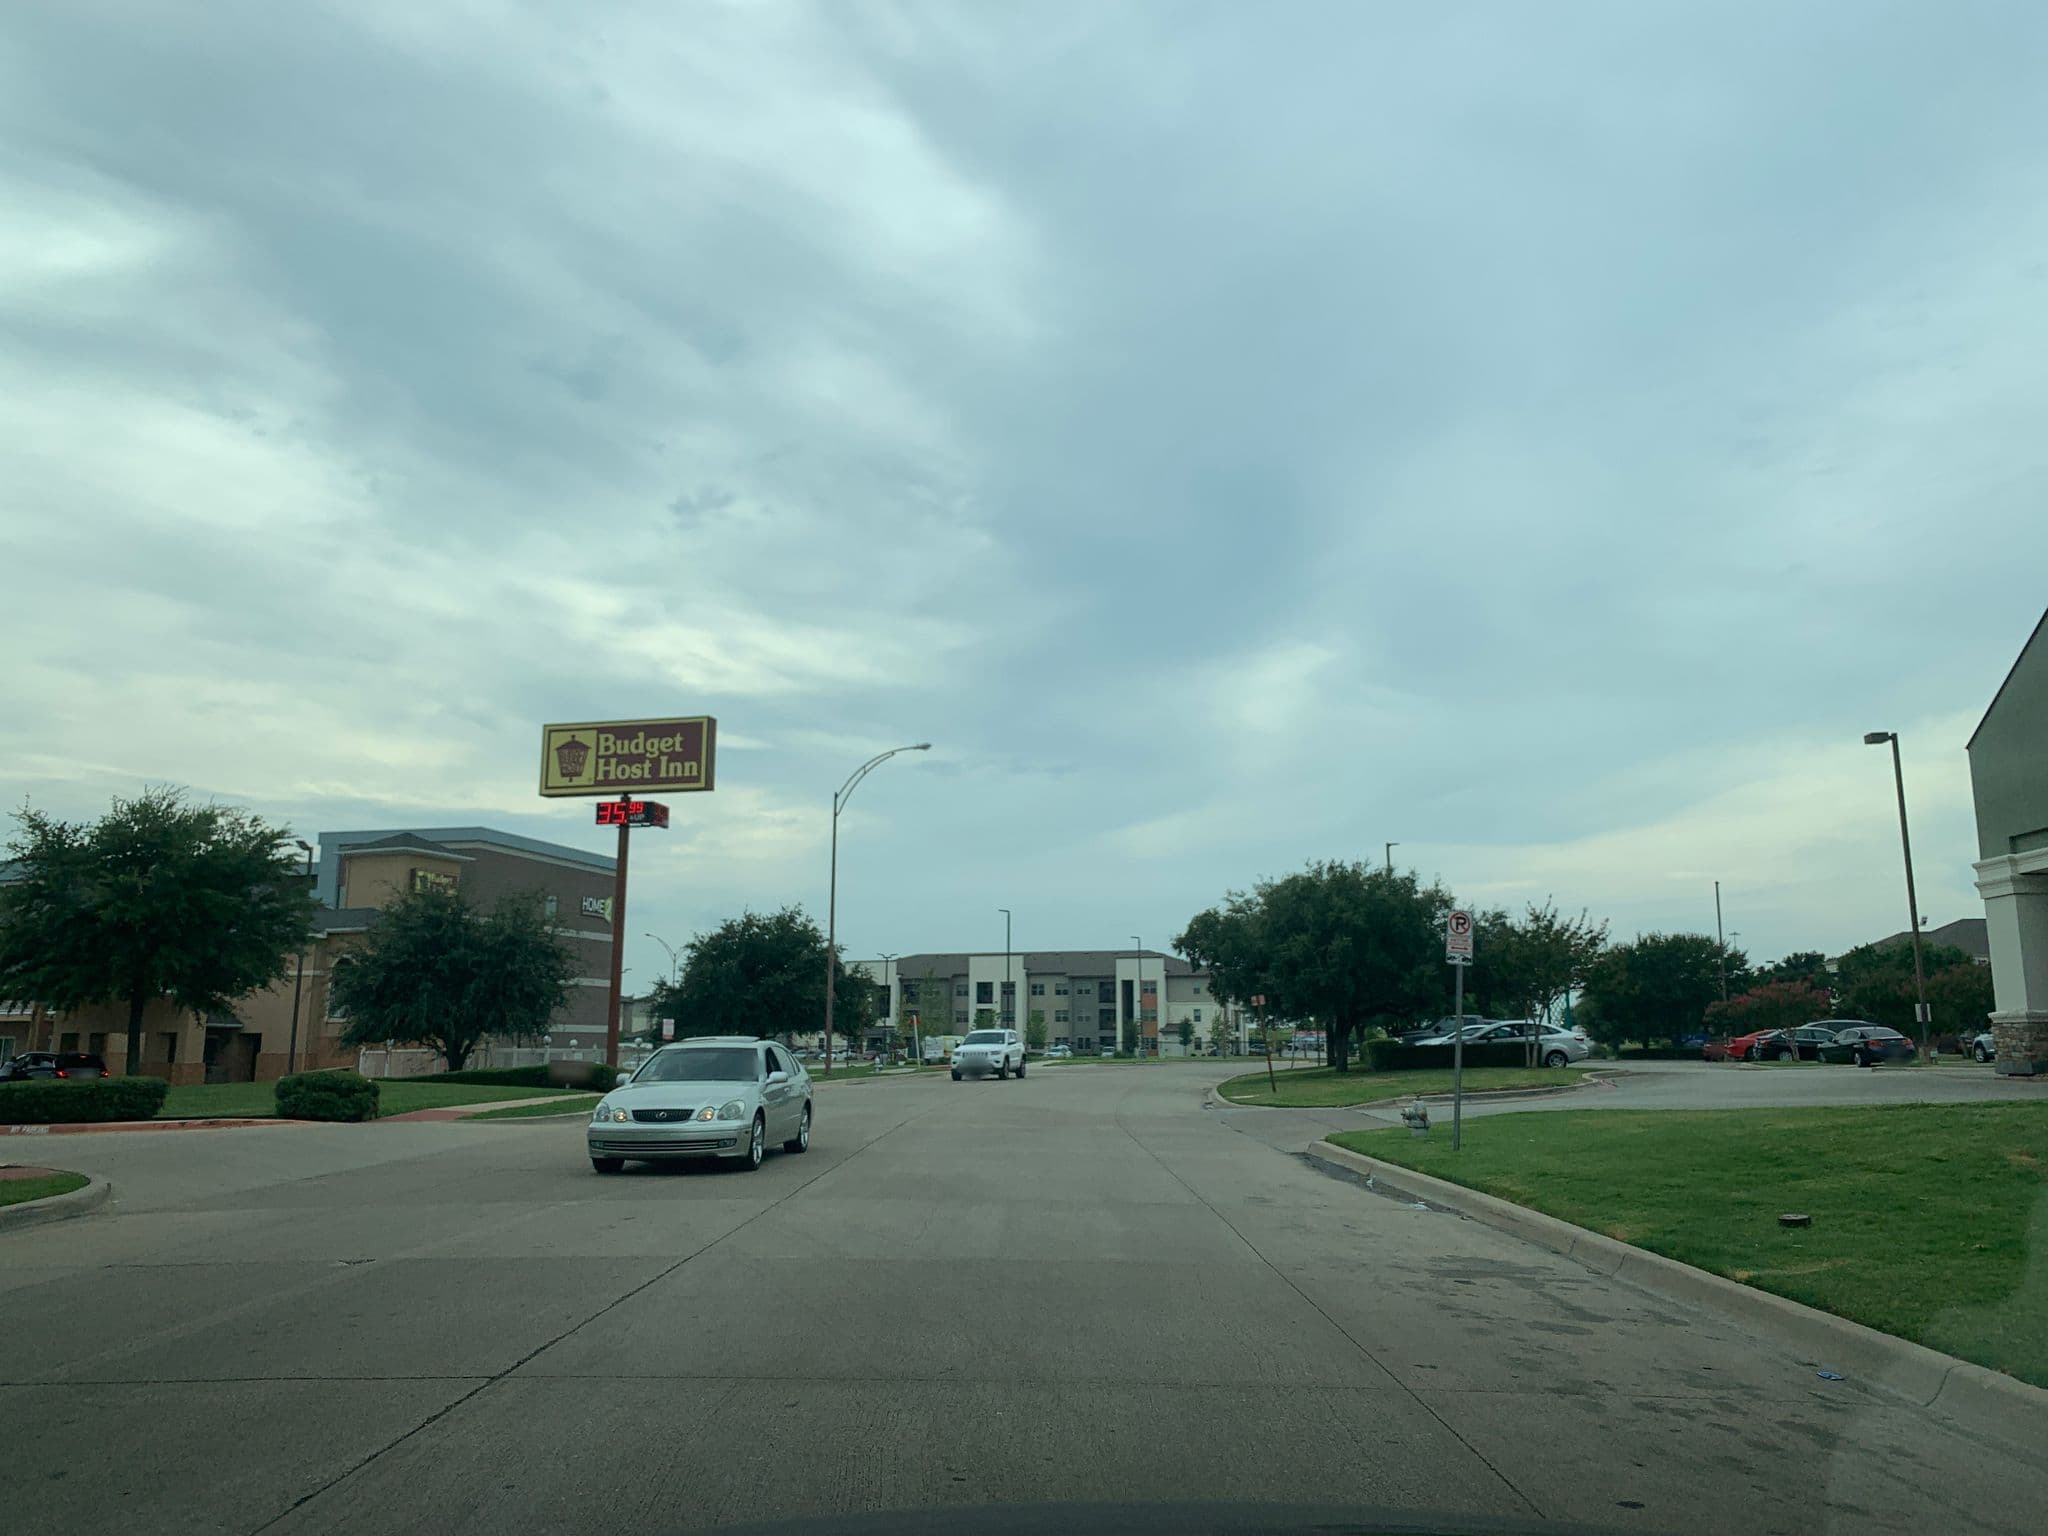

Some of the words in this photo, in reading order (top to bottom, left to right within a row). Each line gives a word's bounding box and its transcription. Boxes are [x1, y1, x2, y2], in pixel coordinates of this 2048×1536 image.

[598, 731, 684, 758] Budget
[597, 757, 652, 780] Host
[660, 755, 698, 777] Inn
